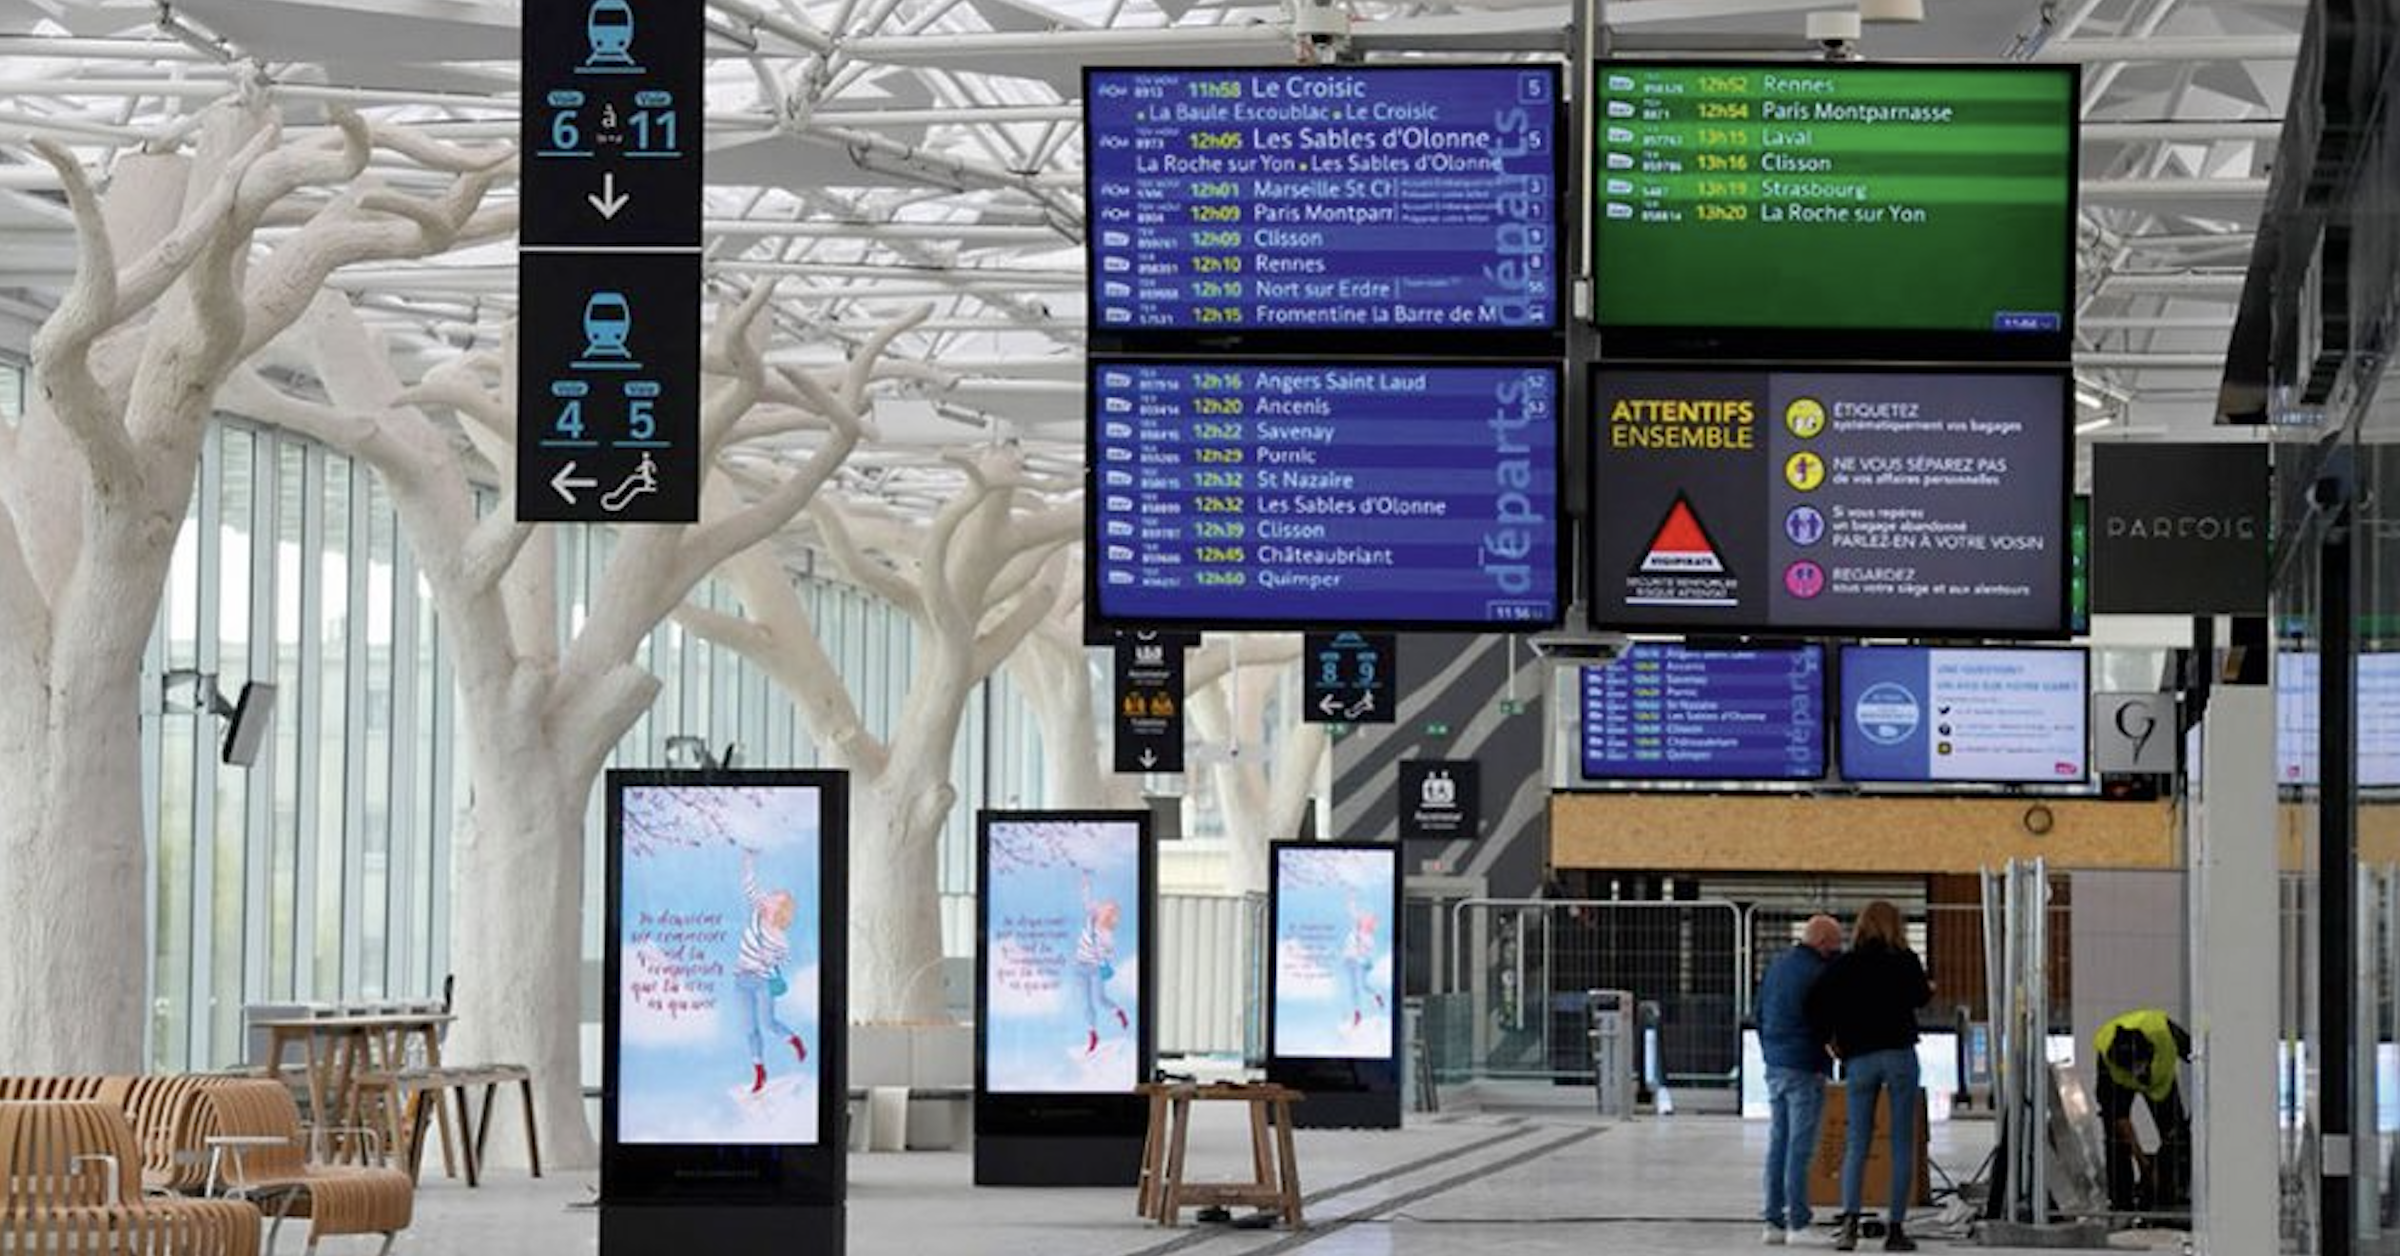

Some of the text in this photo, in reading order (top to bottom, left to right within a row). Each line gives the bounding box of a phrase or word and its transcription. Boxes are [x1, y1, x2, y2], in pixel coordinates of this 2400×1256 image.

[1252, 77, 1280, 97] Le
[1285, 77, 1366, 97] Croisic
[1529, 81, 1541, 95] 5
[1764, 75, 1834, 94] Rennes
[1150, 103, 1438, 121] La Baule Escoublac Le Croisic
[1698, 101, 1748, 119] 12h54
[1762, 101, 1808, 120] Paris
[1814, 101, 1953, 123] Montparnasse
[552, 110, 579, 149] 6
[628, 110, 676, 149] 11
[1189, 132, 1242, 149] 12h05
[1254, 128, 1293, 150] Les
[1300, 128, 1377, 150] Sables
[1383, 127, 1490, 150] d'Olonne
[1529, 133, 1541, 149] 5
[1698, 127, 1812, 145] 13h15 Laval
[1136, 153, 1503, 173] La Roche sur Yon Les Sables d'Olonne
[1698, 153, 1832, 172] 13h16 Clisson
[1190, 182, 1240, 198] 12h01
[1254, 180, 1338, 198] Marseille
[1346, 181, 1367, 198] St
[1762, 179, 1867, 200] Strasbourg
[1190, 205, 1241, 222] 12h09
[1254, 204, 1299, 222] Paris
[1762, 205, 1783, 221] La
[1788, 204, 1850, 222] Roche
[1855, 207, 1884, 222] sur
[1889, 205, 1925, 222] Yon
[1191, 230, 1241, 247] 12h09
[1254, 229, 1323, 247] Clisson
[1191, 256, 1241, 273] 12h10
[1256, 256, 1325, 273] Rennes
[1191, 281, 1242, 298] 12h10
[1256, 280, 1298, 298] Nort
[1304, 283, 1333, 298] sur
[1339, 280, 1391, 298] Erdre
[1192, 305, 1498, 324] 12h15 Fromentine la Barre de M
[1193, 372, 1242, 389] 12h16
[1256, 373, 1324, 393] Angers
[1328, 372, 1376, 390] Saint
[1380, 372, 1426, 390] Laud
[1194, 397, 1243, 414] 12h20
[1256, 396, 1331, 415] Ancenis
[1611, 400, 1755, 423] ATTENTIFS
[1833, 402, 1919, 418] ÉTIQUETEZ
[556, 401, 656, 438] 4 5
[1833, 415, 2022, 433] systématiquement vos bagages
[1194, 422, 1335, 443] 12h22 Savenay
[1612, 426, 1755, 449] ENSEMBLE
[1195, 446, 1317, 464] 12h29 Pornic
[1833, 454, 2008, 473] NE VOUS SÉPAREZ PAS
[1194, 471, 1354, 490] 12h32 St Nazaire
[1485, 379, 1545, 595] départs
[1833, 471, 2000, 489] de vos affaires personnelles
[1195, 495, 1447, 516] 12h32 Les Sables d'Olonne
[1832, 505, 1845, 519] Si
[1848, 508, 1876, 518] vous
[1195, 520, 1325, 538] 12h39 Clisson
[1833, 518, 1967, 534] un bagage abandonné
[2107, 517, 2254, 541] PARFOIS
[1934, 535, 1986, 549] VOTRE
[1990, 535, 2044, 550] VOISIN
[1257, 544, 1393, 563] Châteaubriant
[1259, 570, 1342, 590] Quimper
[1833, 567, 1915, 582] REGARDEZ
[1833, 581, 2030, 597] sous votre siège et aux alentours
[1322, 661, 1375, 683] 8 9
